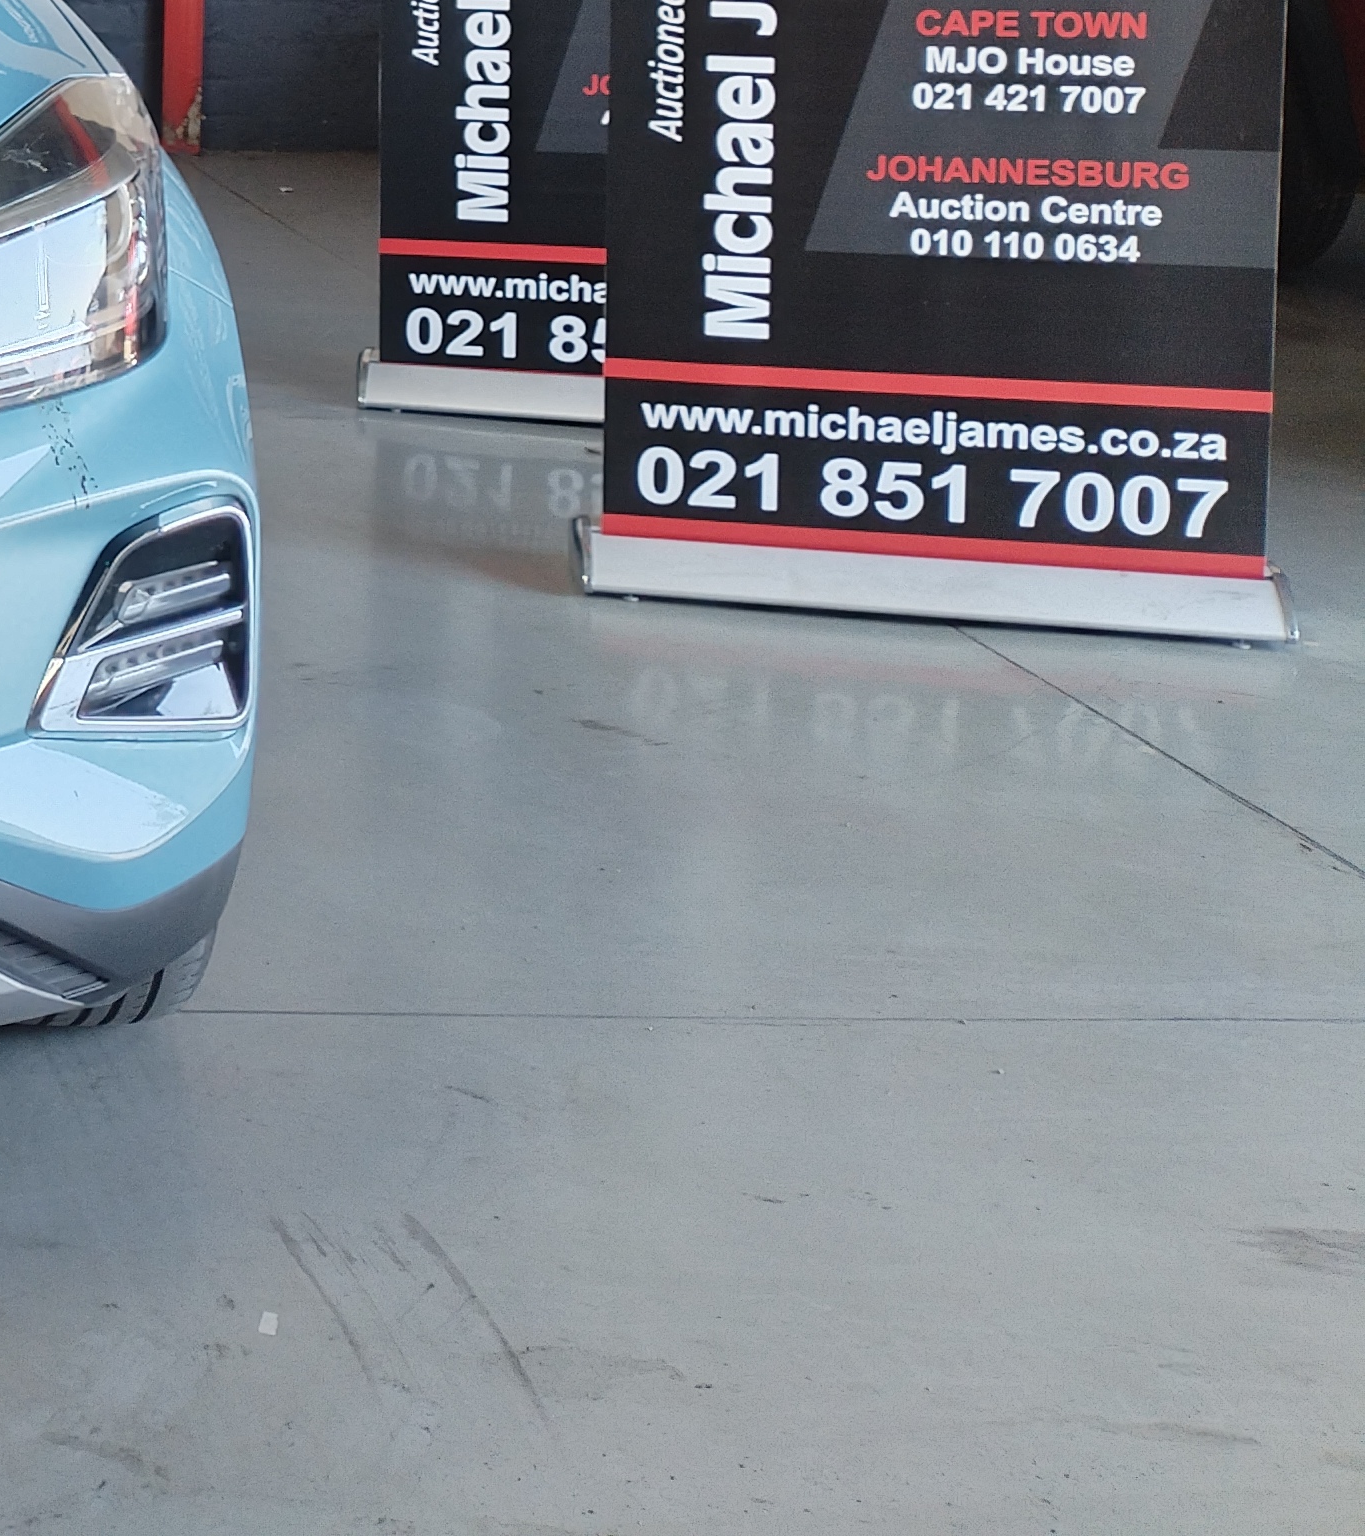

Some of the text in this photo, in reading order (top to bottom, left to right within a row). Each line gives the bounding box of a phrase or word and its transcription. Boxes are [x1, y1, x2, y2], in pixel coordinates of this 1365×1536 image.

[915, 9, 1147, 39] CAPE TOWN
[925, 45, 1136, 77] MJO House
[912, 81, 1147, 114] 021 421 7007
[866, 154, 1190, 190] JOHANNESBURG
[702, 54, 776, 340] Michael
[888, 191, 1163, 227] Auction Centre
[909, 227, 1141, 263] 010 110 0634
[408, 272, 608, 304] www.micha
[405, 307, 517, 359] 021
[641, 401, 1227, 461] www.michaeljames.co.za
[637, 446, 779, 512] 021
[820, 457, 967, 524] 851
[1009, 468, 1229, 539] 7007
